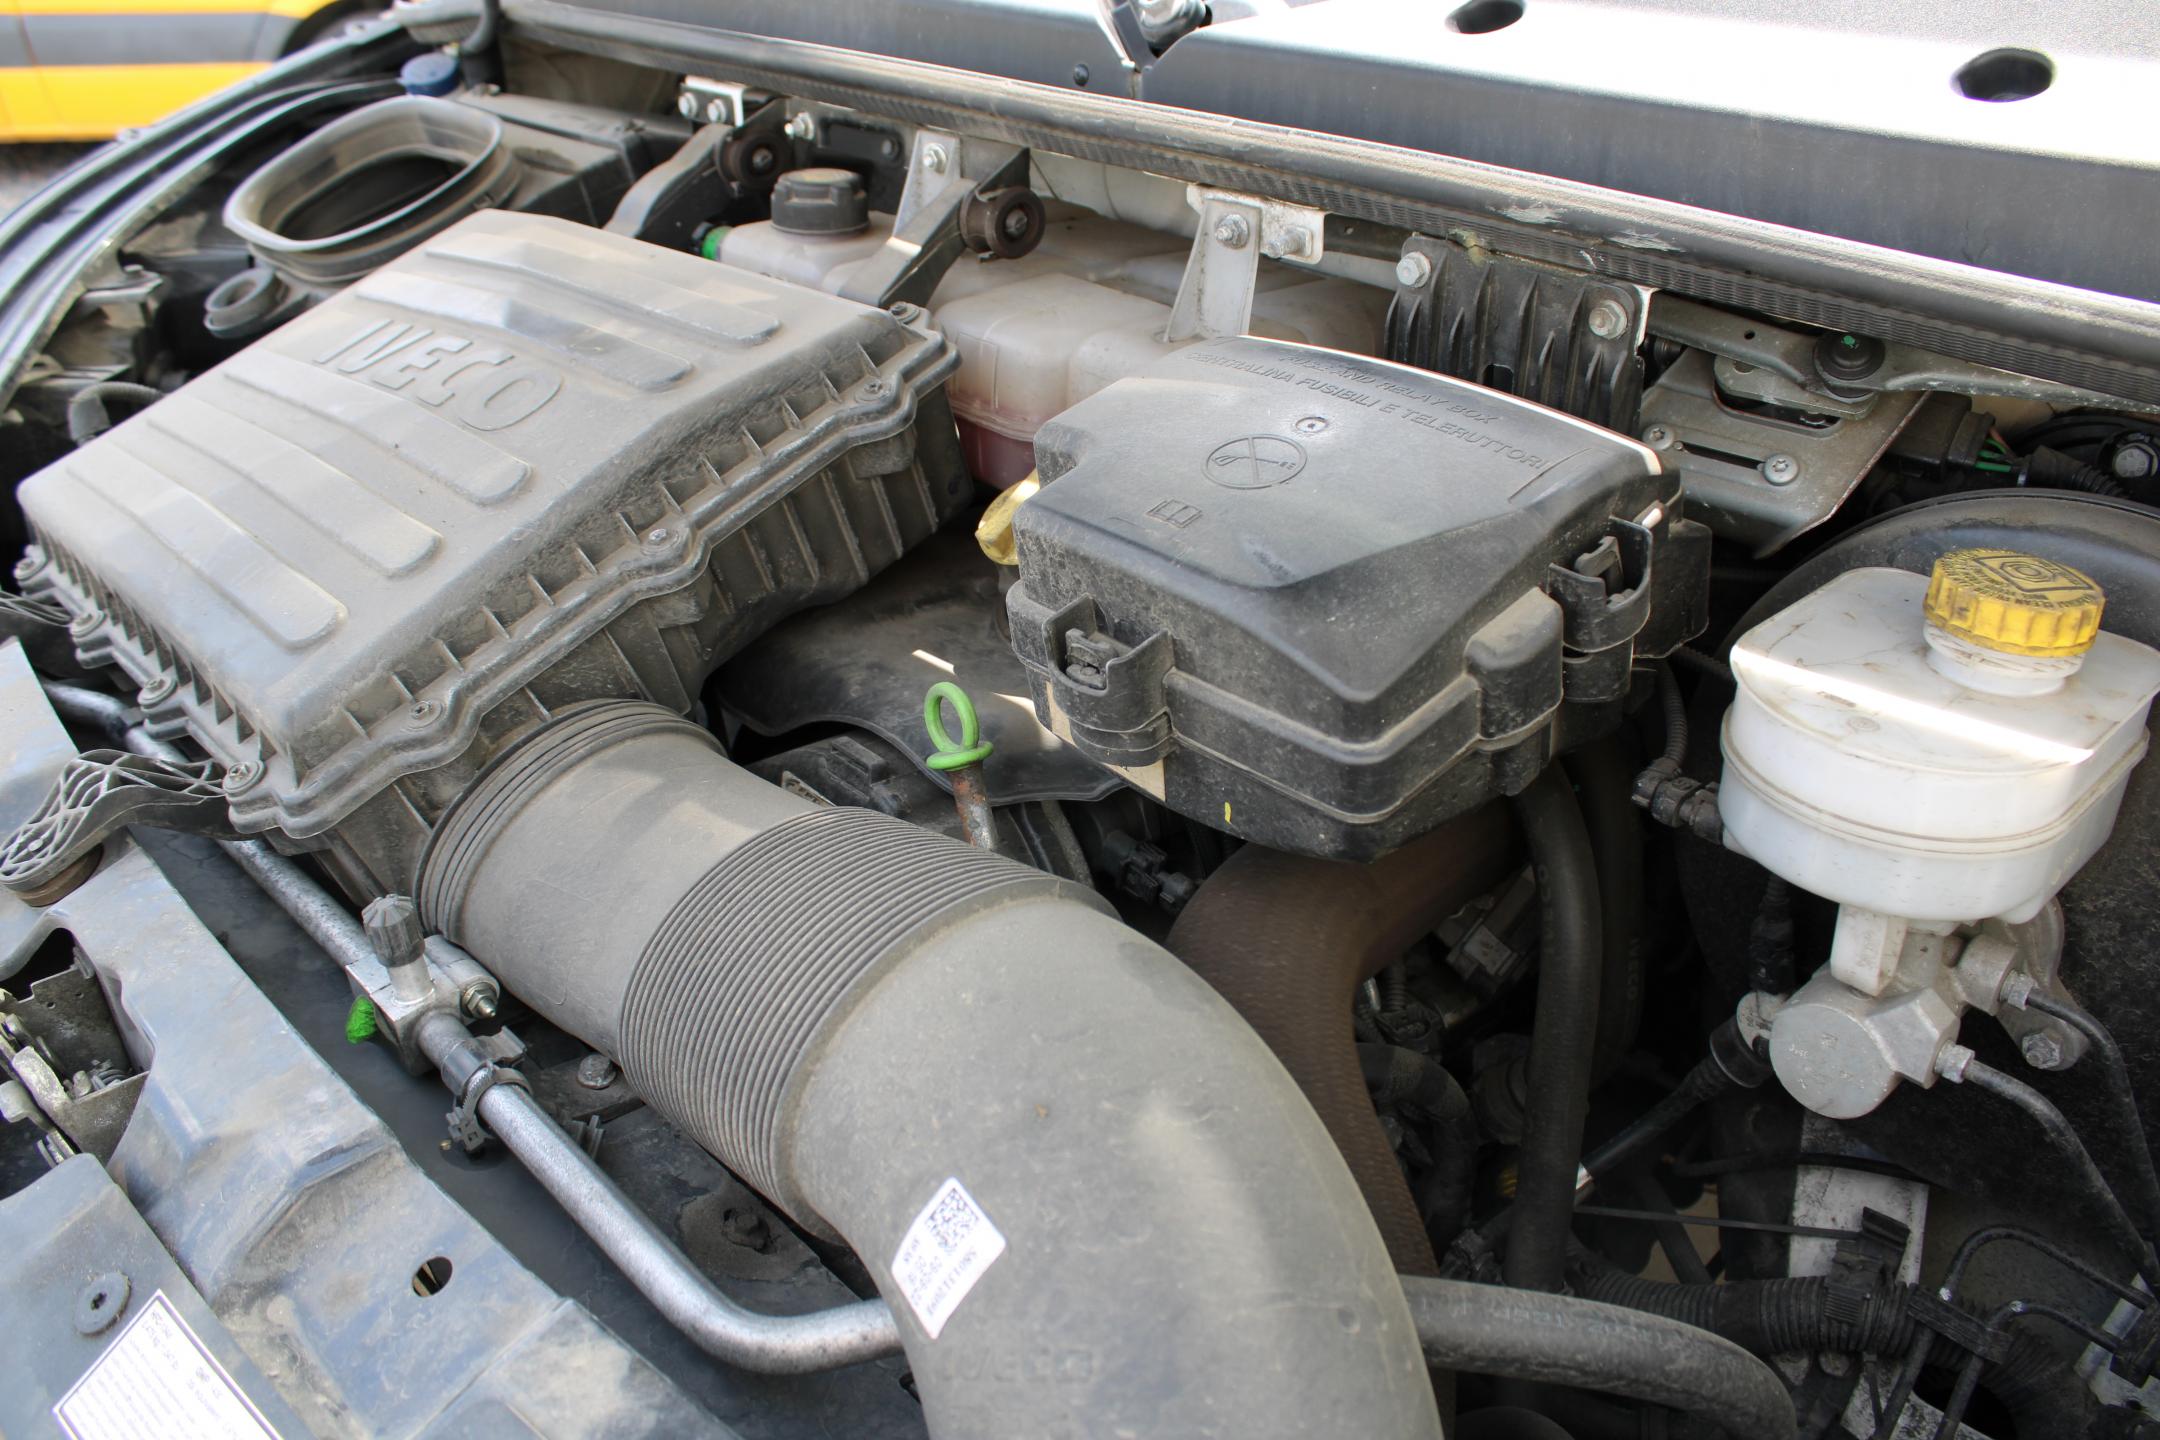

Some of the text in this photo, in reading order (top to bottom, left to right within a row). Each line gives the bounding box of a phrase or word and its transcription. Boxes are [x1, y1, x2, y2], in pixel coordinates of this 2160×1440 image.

[312, 319, 565, 432] IVECO
[1186, 352, 1549, 470] CENTRALINA FUSIBILI E TELERUTTORI
[1329, 366, 1376, 384] AND
[1375, 381, 1449, 406] RELAY
[1446, 404, 1498, 425] BOX
